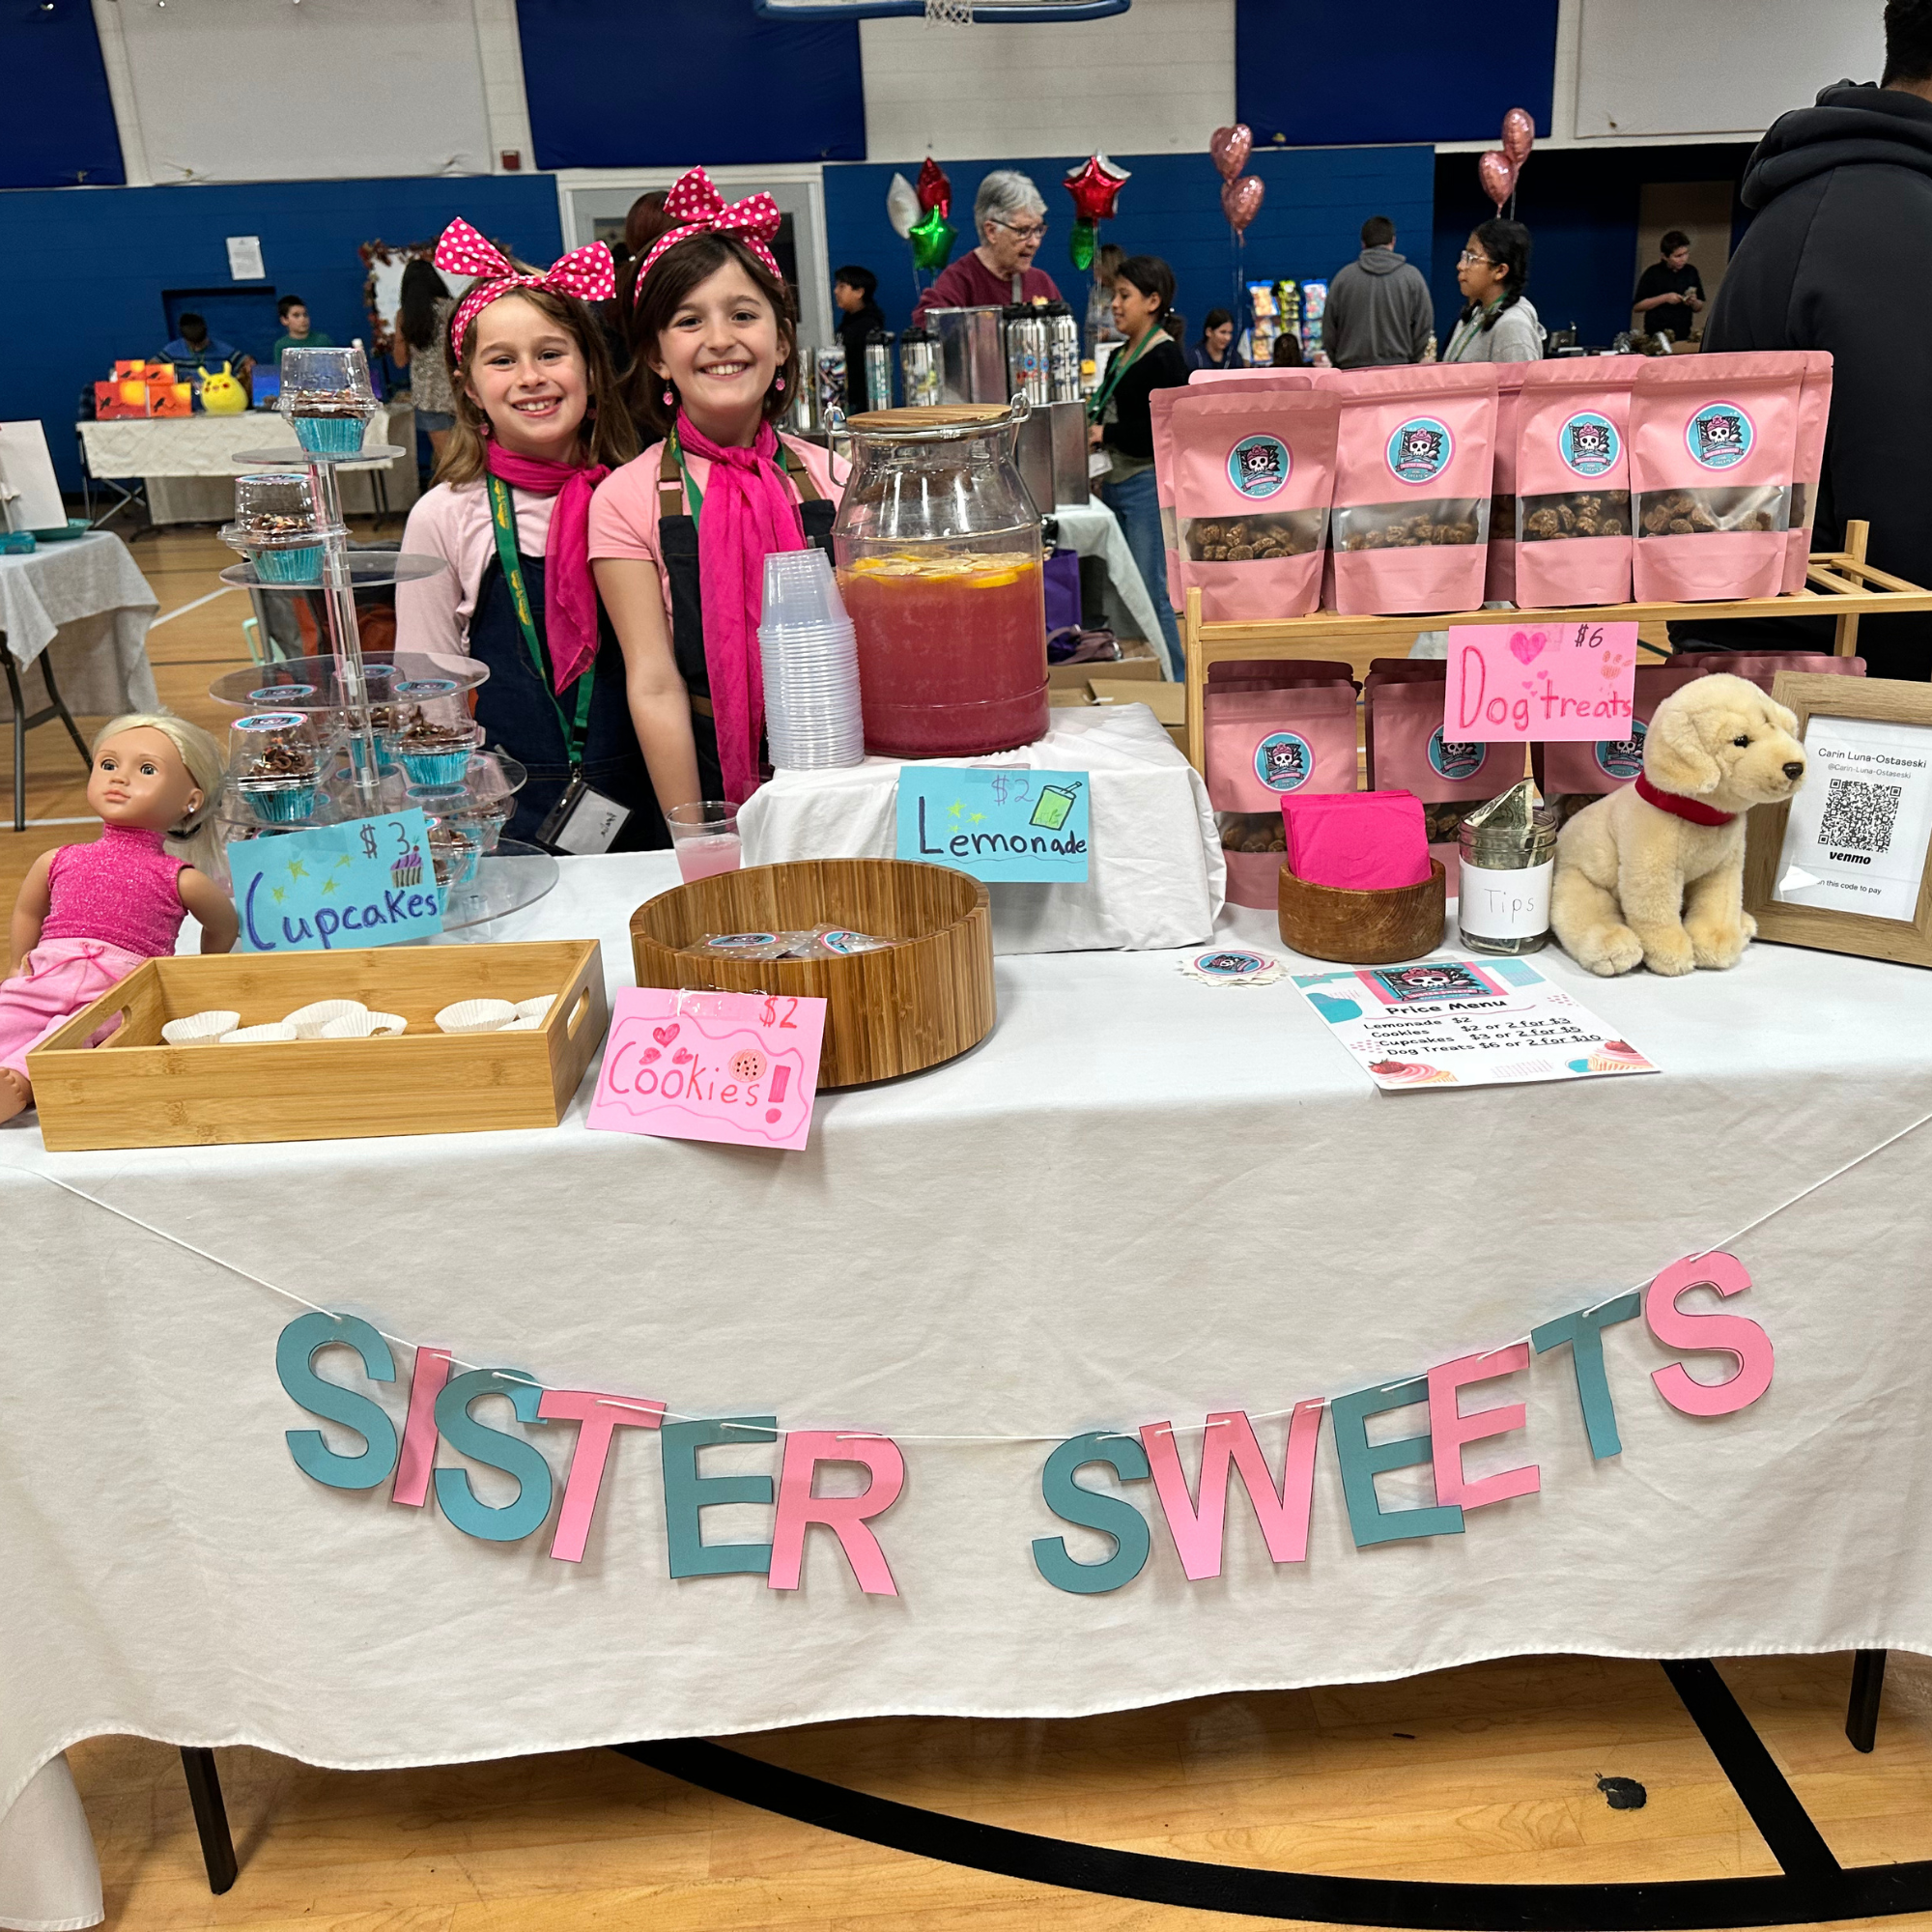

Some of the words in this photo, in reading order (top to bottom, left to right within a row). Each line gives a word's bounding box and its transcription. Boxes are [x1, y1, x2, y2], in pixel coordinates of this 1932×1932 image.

[1575, 624, 1604, 647] $6
[1460, 645, 1529, 731] Dog
[1540, 679, 1633, 720] treats
[1818, 748, 1845, 758] Carin
[1847, 752, 1927, 768] Luna-Ostaseski
[1828, 763, 1911, 779] @Carin-Luna-Ostaseski
[991, 775, 1034, 806] $2
[919, 796, 1088, 857] Lemonade
[1830, 851, 1871, 865] venmo
[245, 871, 438, 950] Cupcakes
[1484, 889, 1535, 923] Tips
[759, 995, 798, 1029] $2
[1385, 1006, 1442, 1014] Price
[1448, 1000, 1507, 1010] Menu
[1363, 1020, 1442, 1030] Lemonade
[1372, 1029, 1430, 1038] Cookies
[1379, 1037, 1455, 1046] Cupcakes
[1420, 1044, 1475, 1053] Treats
[1541, 1037, 1567, 1045] for
[1571, 1034, 1602, 1042] $10
[276, 1312, 905, 1596] SISTER
[1029, 1250, 1775, 1594] SWEETS
